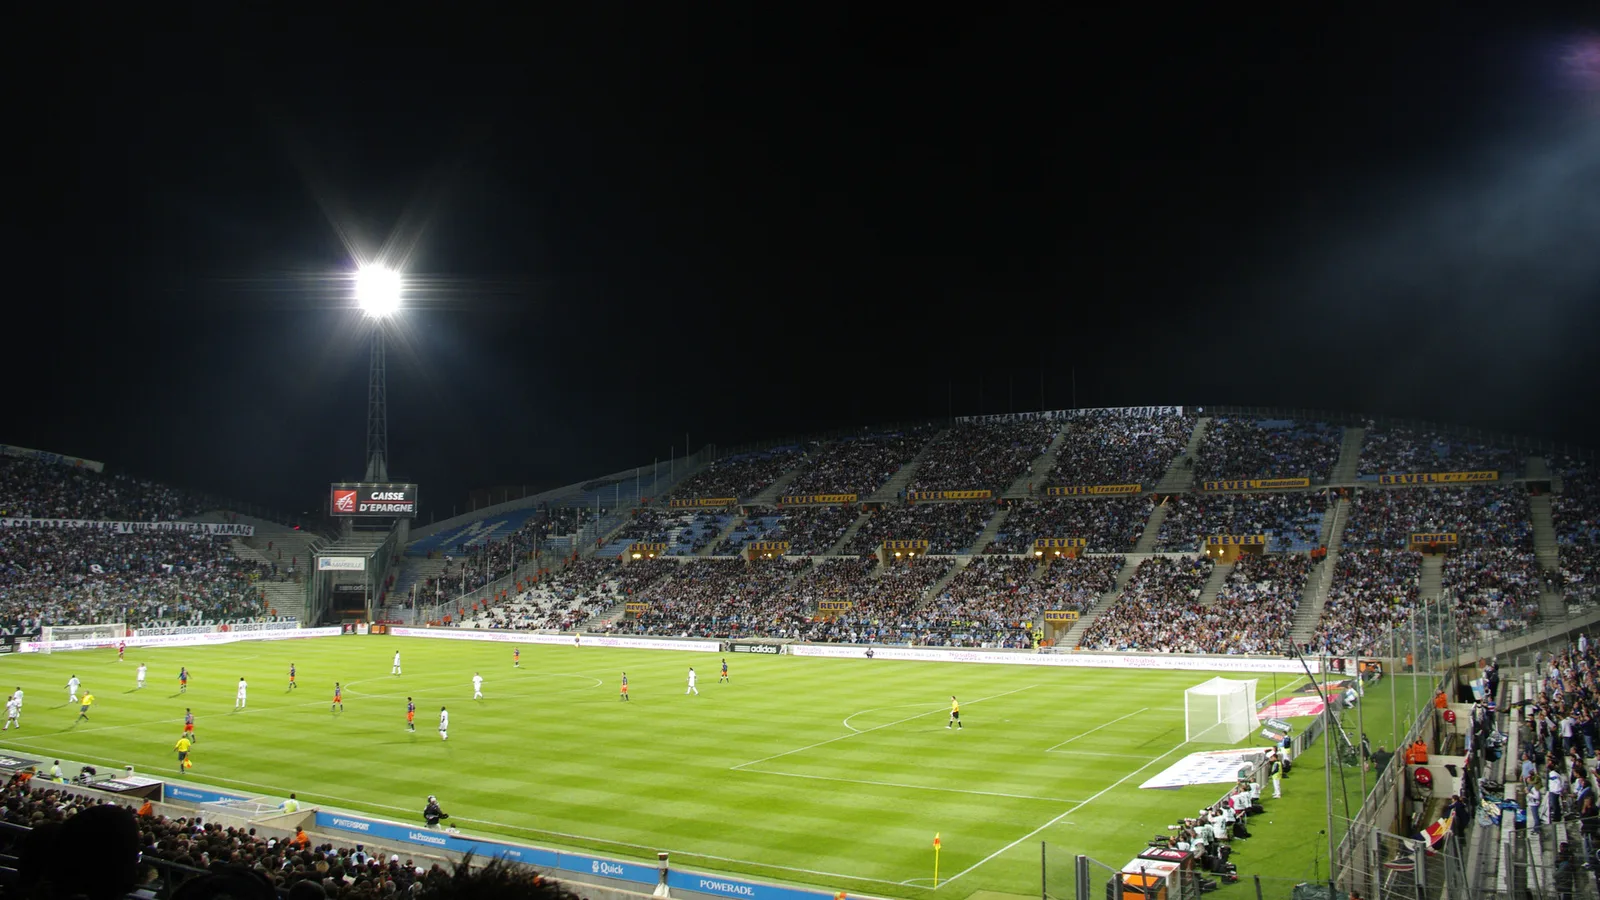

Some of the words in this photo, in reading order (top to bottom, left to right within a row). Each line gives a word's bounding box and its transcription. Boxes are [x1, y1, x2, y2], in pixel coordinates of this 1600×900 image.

[1382, 474, 1436, 484] REVEL
[1466, 472, 1493, 480] PACA
[1207, 480, 1254, 490] REVEL
[909, 491, 948, 500] REVEL
[1049, 487, 1091, 495] REVEL
[371, 492, 404, 500] CAISSE
[783, 495, 818, 504] REVEL
[359, 503, 413, 512] D'EPARGNE
[122, 522, 152, 532] VOUS
[213, 524, 252, 535] JAMAIS
[1210, 536, 1262, 544] REVEL
[751, 542, 787, 550] REVEL
[886, 541, 926, 549] REVEL
[750, 645, 777, 654] adidas
[338, 819, 370, 831] INTERSPORT
[409, 831, 418, 839] La
[418, 832, 446, 844] Provence
[600, 862, 623, 875] Quick
